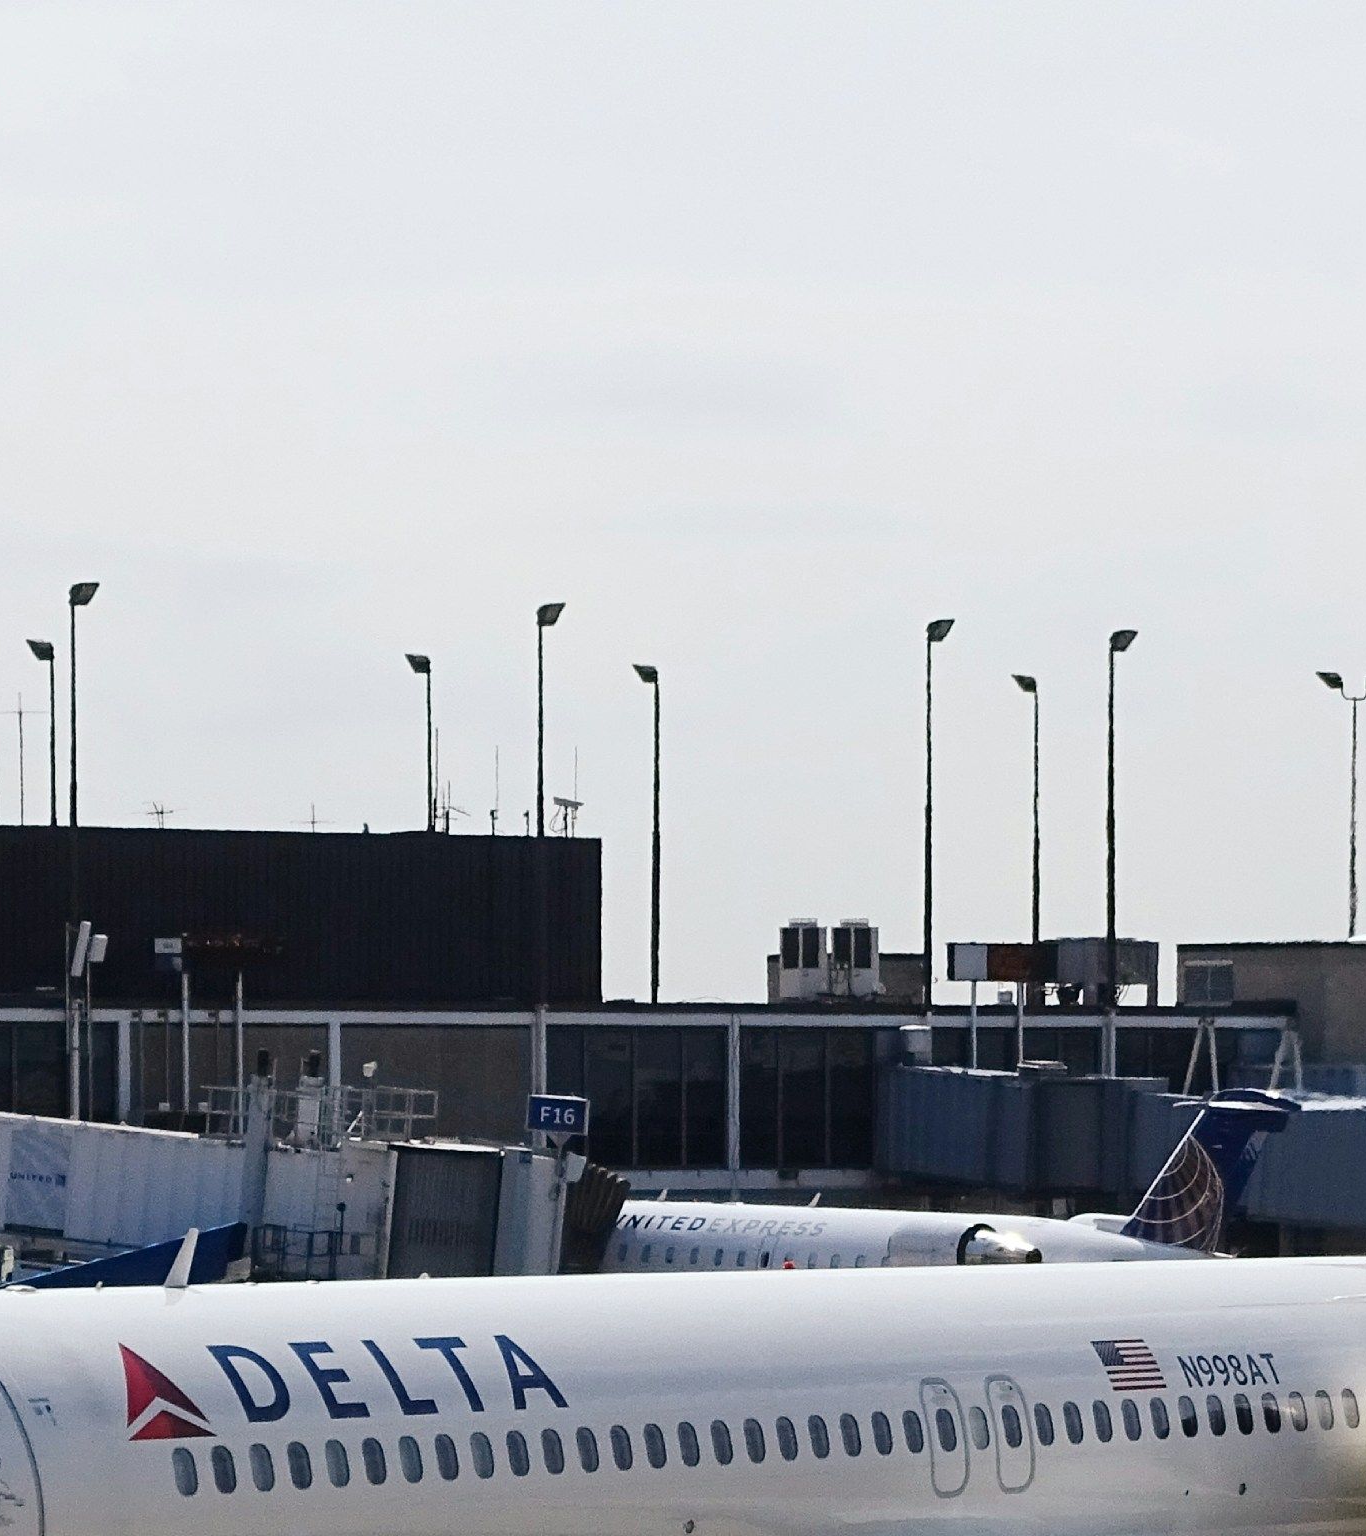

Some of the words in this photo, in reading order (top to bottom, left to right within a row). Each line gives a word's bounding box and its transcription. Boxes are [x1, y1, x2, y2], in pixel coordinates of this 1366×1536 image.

[540, 1106, 575, 1125] F16
[707, 1217, 828, 1238] EXPRESS
[206, 1335, 570, 1423] DELTA
[1177, 1353, 1280, 1388] N998AT
